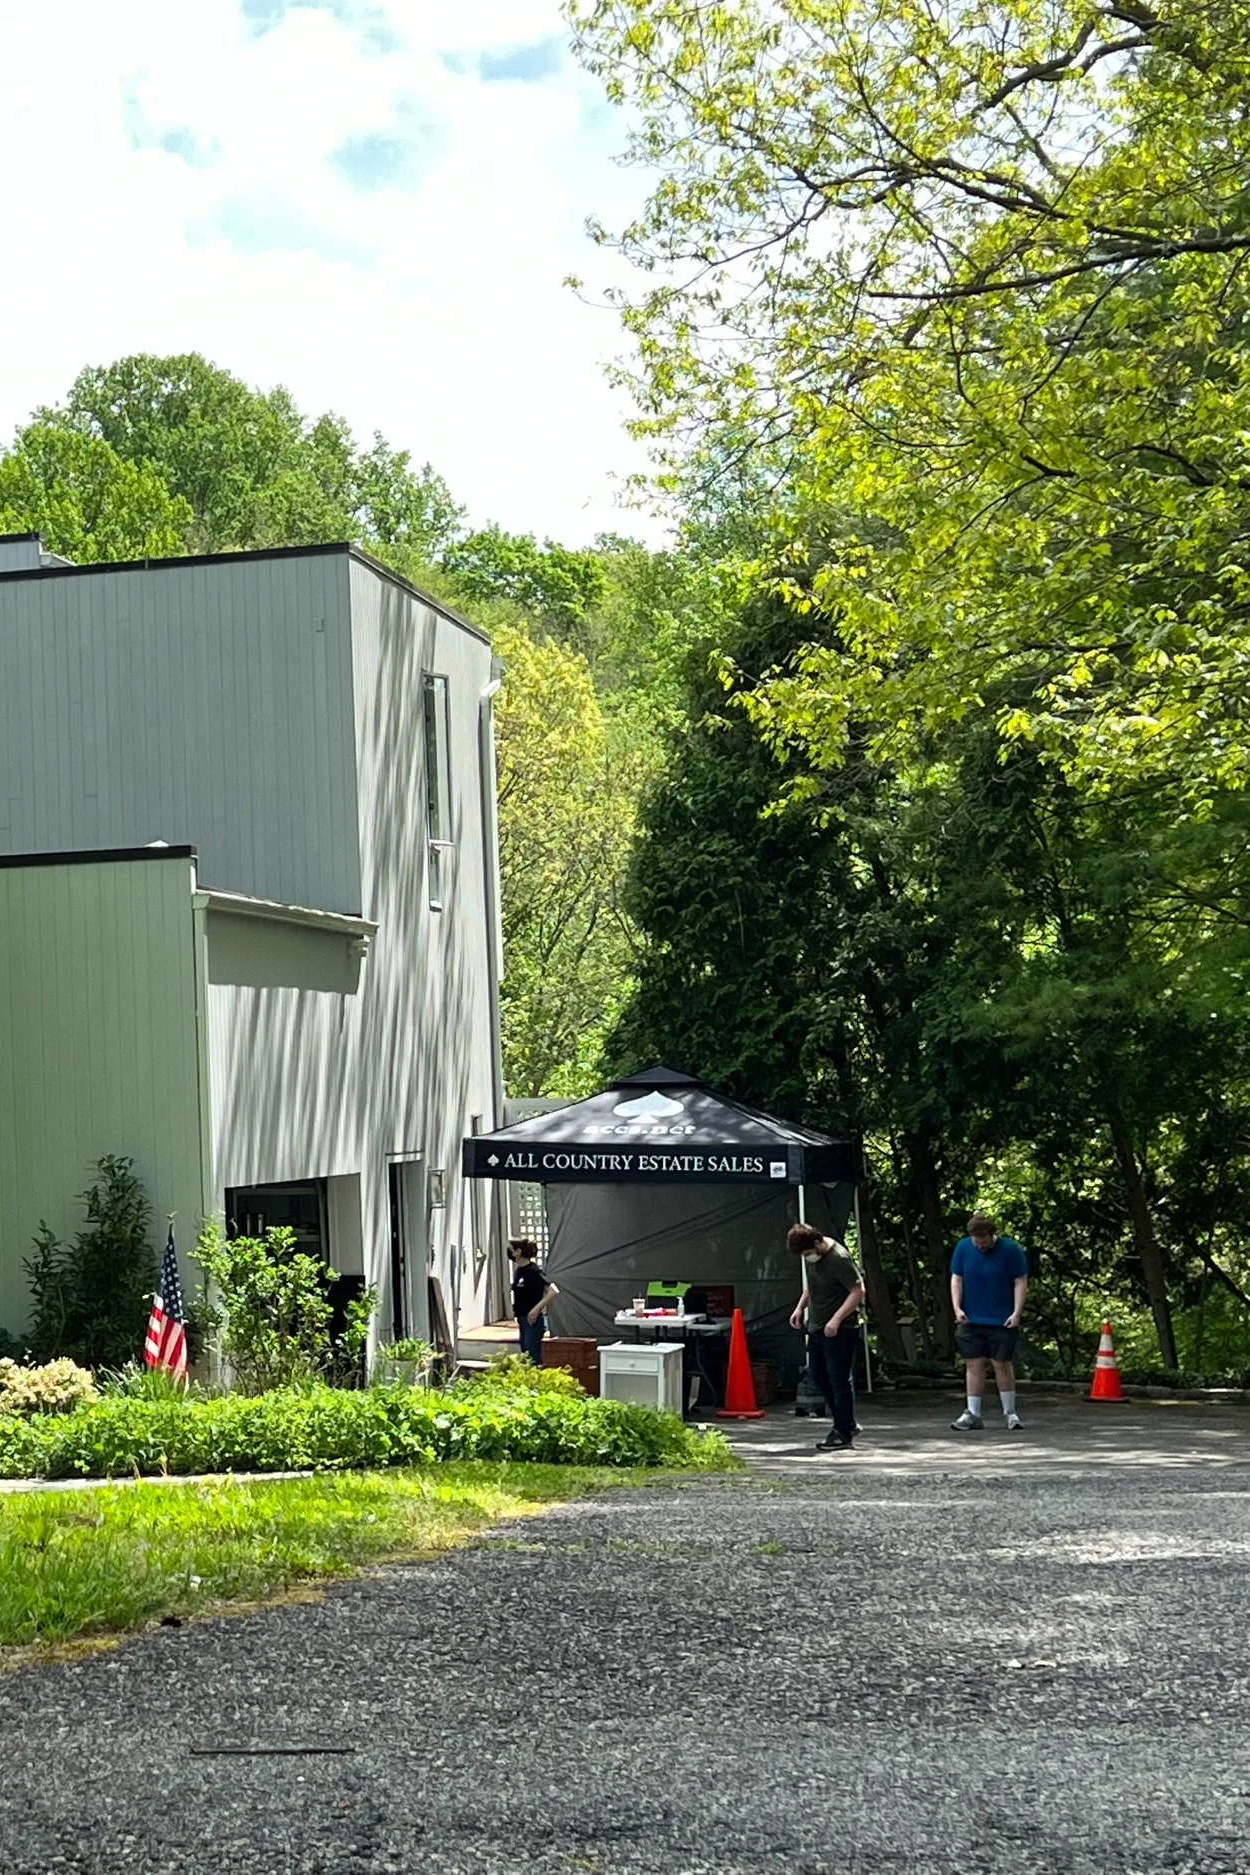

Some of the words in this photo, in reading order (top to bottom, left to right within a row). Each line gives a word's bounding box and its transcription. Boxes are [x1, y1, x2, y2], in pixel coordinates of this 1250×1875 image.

[504, 1153, 539, 1169] ALL
[542, 1153, 634, 1170] COUNTRY
[637, 1155, 705, 1172] ESTATE
[707, 1156, 764, 1173] SALES
